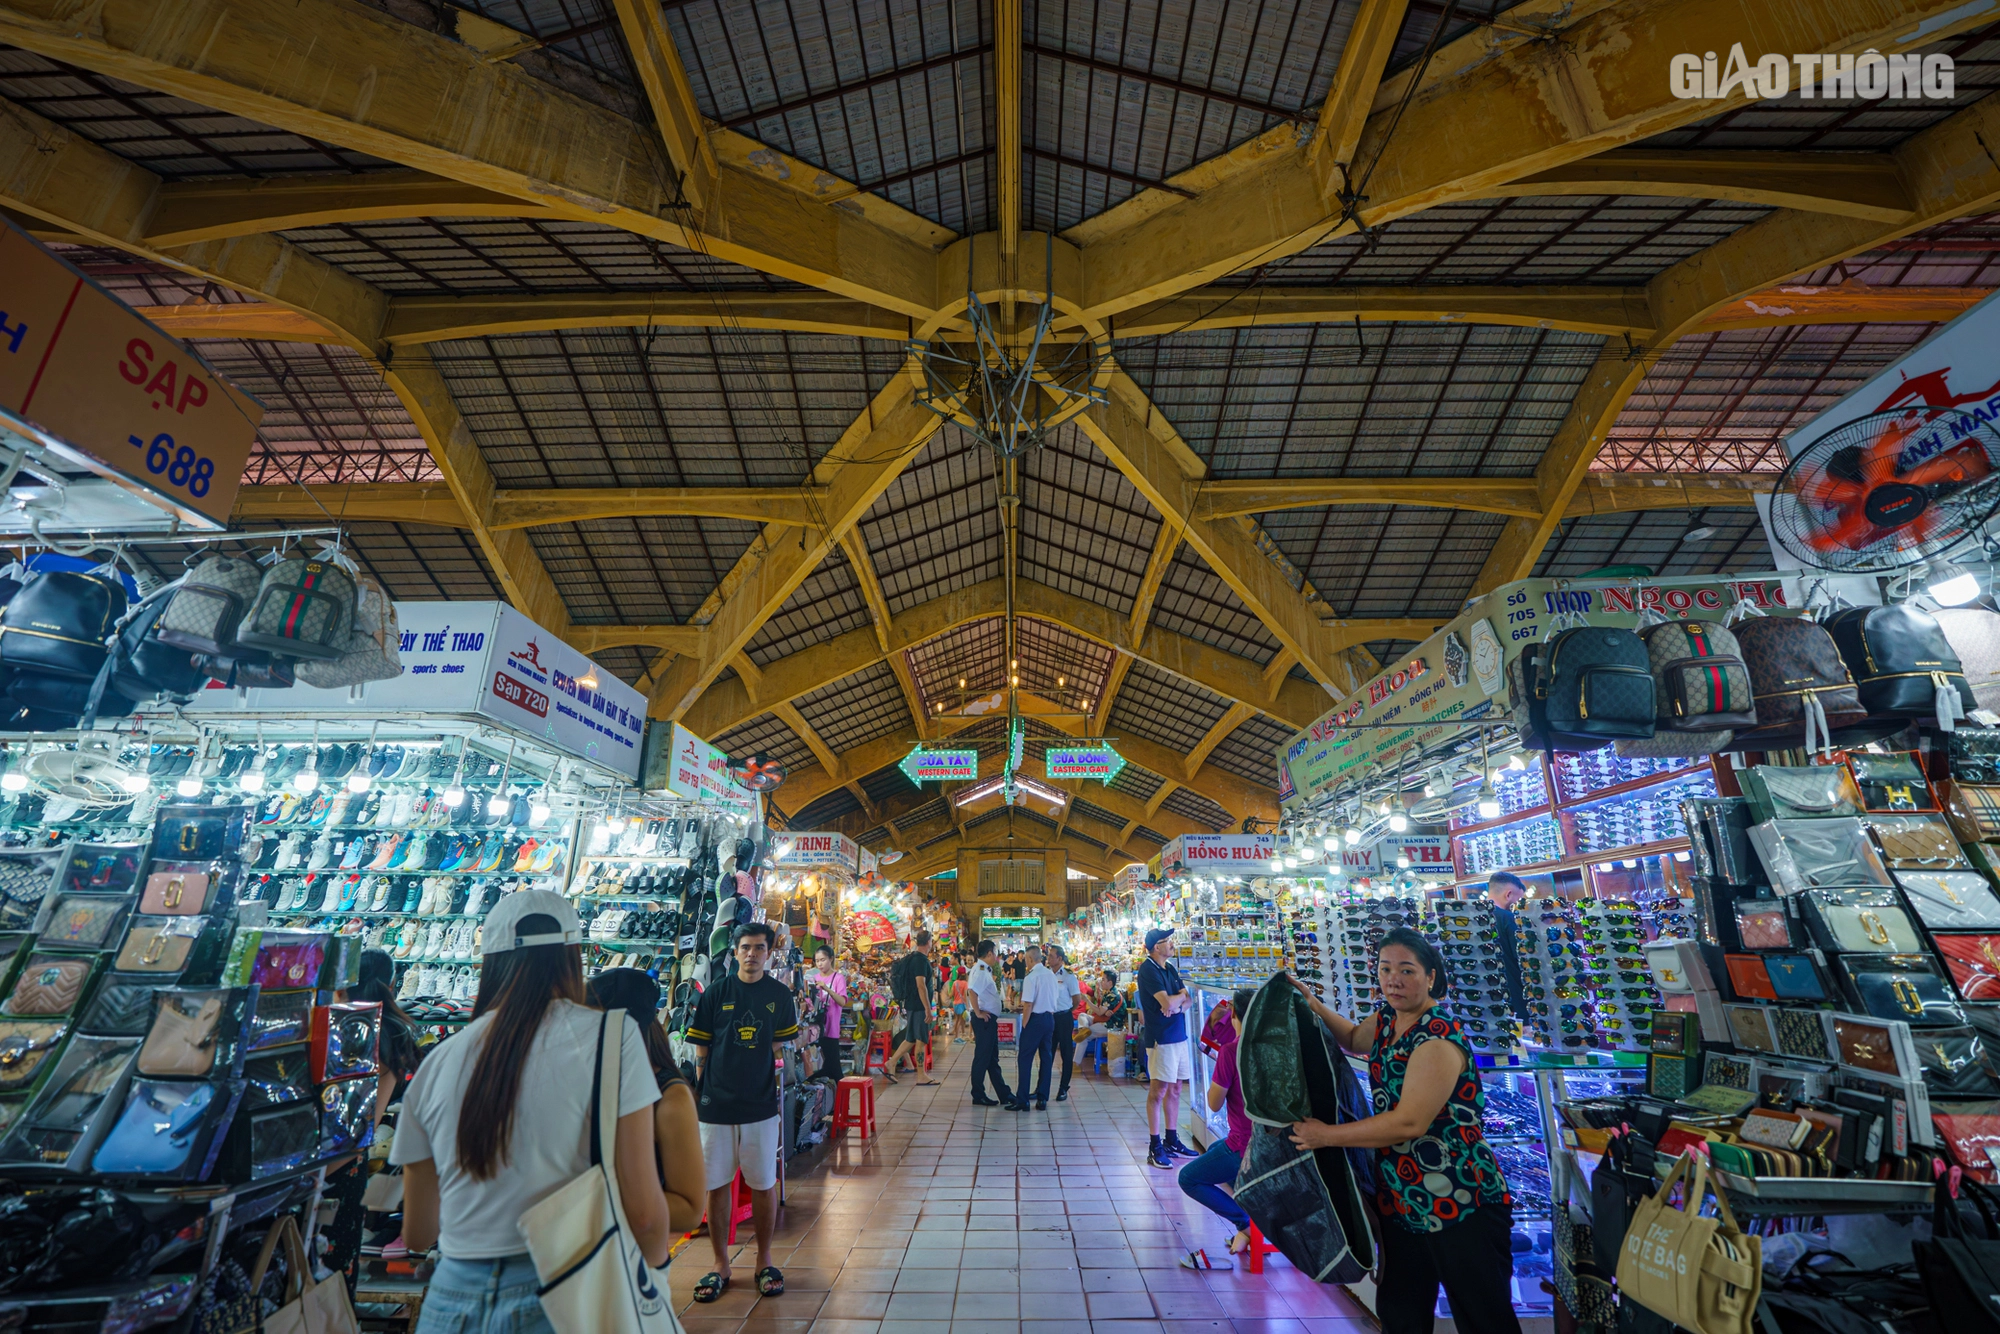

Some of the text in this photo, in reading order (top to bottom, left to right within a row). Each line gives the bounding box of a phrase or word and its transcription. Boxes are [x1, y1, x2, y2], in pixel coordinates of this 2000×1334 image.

[119, 338, 208, 415] SẠP
[128, 433, 214, 498] -688
[1507, 588, 1527, 606] SỐ
[1545, 591, 1592, 614] SHOP
[1599, 585, 1722, 618] Ngọc
[1507, 608, 1536, 624] 705
[422, 625, 450, 651] THỂ
[451, 633, 484, 651] THAO
[1511, 625, 1538, 641] 667
[412, 663, 465, 674] sports shoes
[496, 674, 546, 712] Sạp 720
[1368, 659, 1428, 708] Hoa
[592, 692, 606, 714] BÁN
[628, 714, 642, 735] THAO
[1383, 704, 1401, 723] NIỆM
[1417, 726, 1443, 743] 919150
[917, 754, 971, 766] CỬA TÂY
[1053, 752, 1109, 764] CỬA ĐÔNG
[1309, 777, 1322, 788] HAND
[1321, 770, 1333, 782] BAG
[1338, 751, 1370, 773] JEWELLERY
[1375, 728, 1415, 753] SOUVENIRS
[678, 768, 690, 784] SHOP
[917, 768, 950, 776] WESTERN
[795, 837, 832, 851] TRINH
[1187, 840, 1228, 859] HỒNG
[1231, 844, 1273, 859] HUÂN
[1647, 1223, 1674, 1244] THE
[1654, 1245, 1687, 1275] BAG
